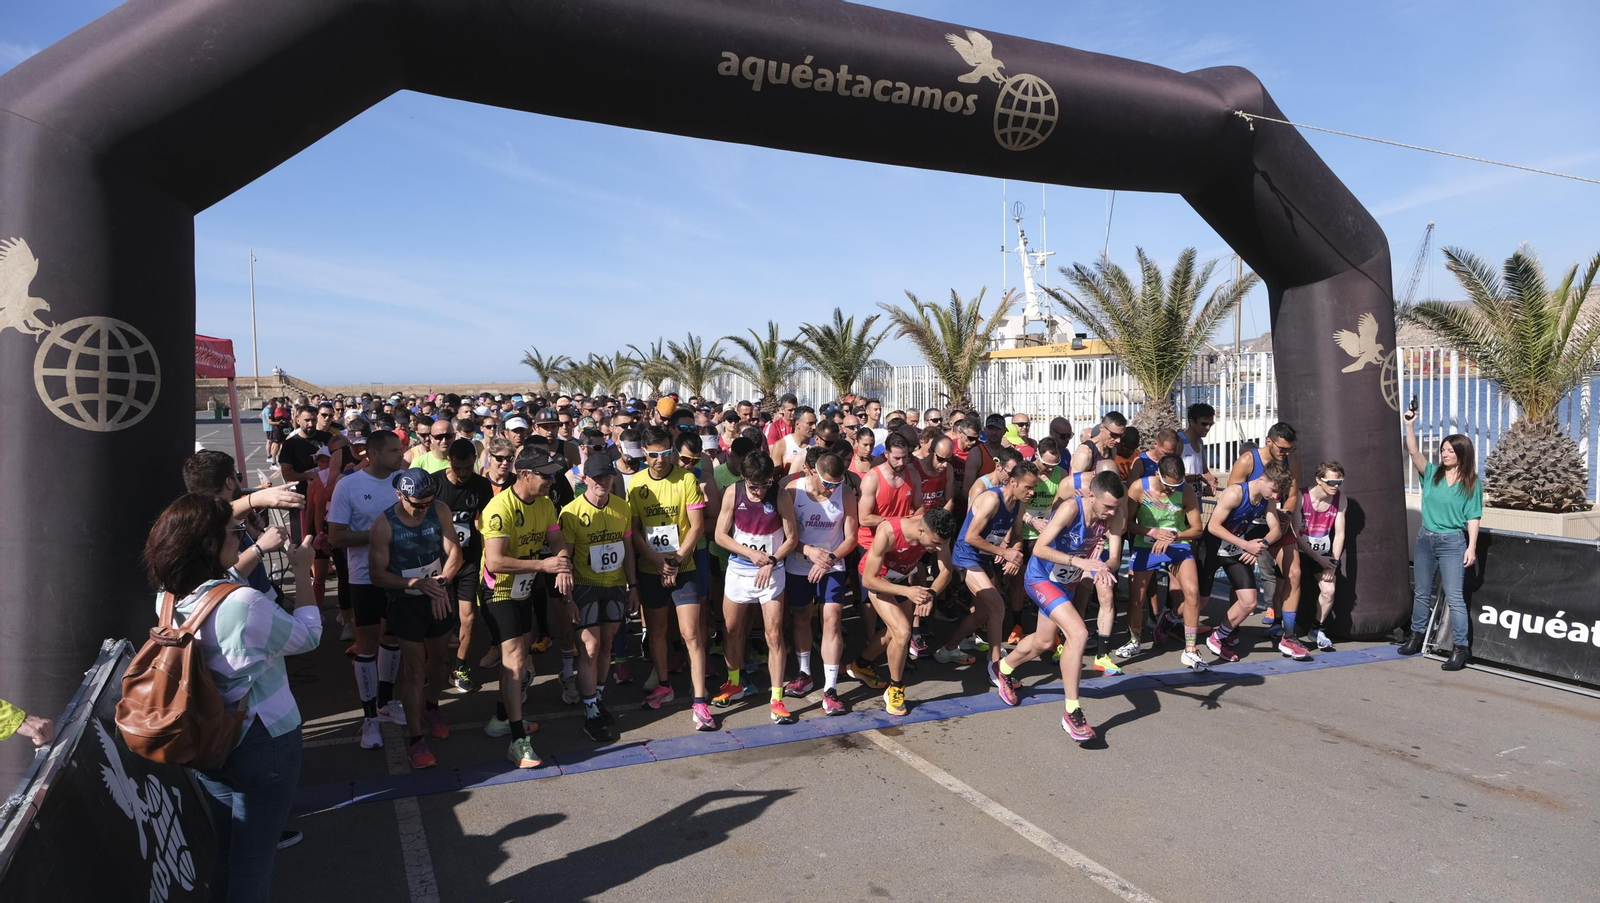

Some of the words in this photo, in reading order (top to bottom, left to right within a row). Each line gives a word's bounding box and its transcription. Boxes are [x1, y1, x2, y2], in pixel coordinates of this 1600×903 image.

[717, 50, 978, 117] aquéatacamos
[652, 534, 669, 547] 46
[601, 551, 618, 565] 60
